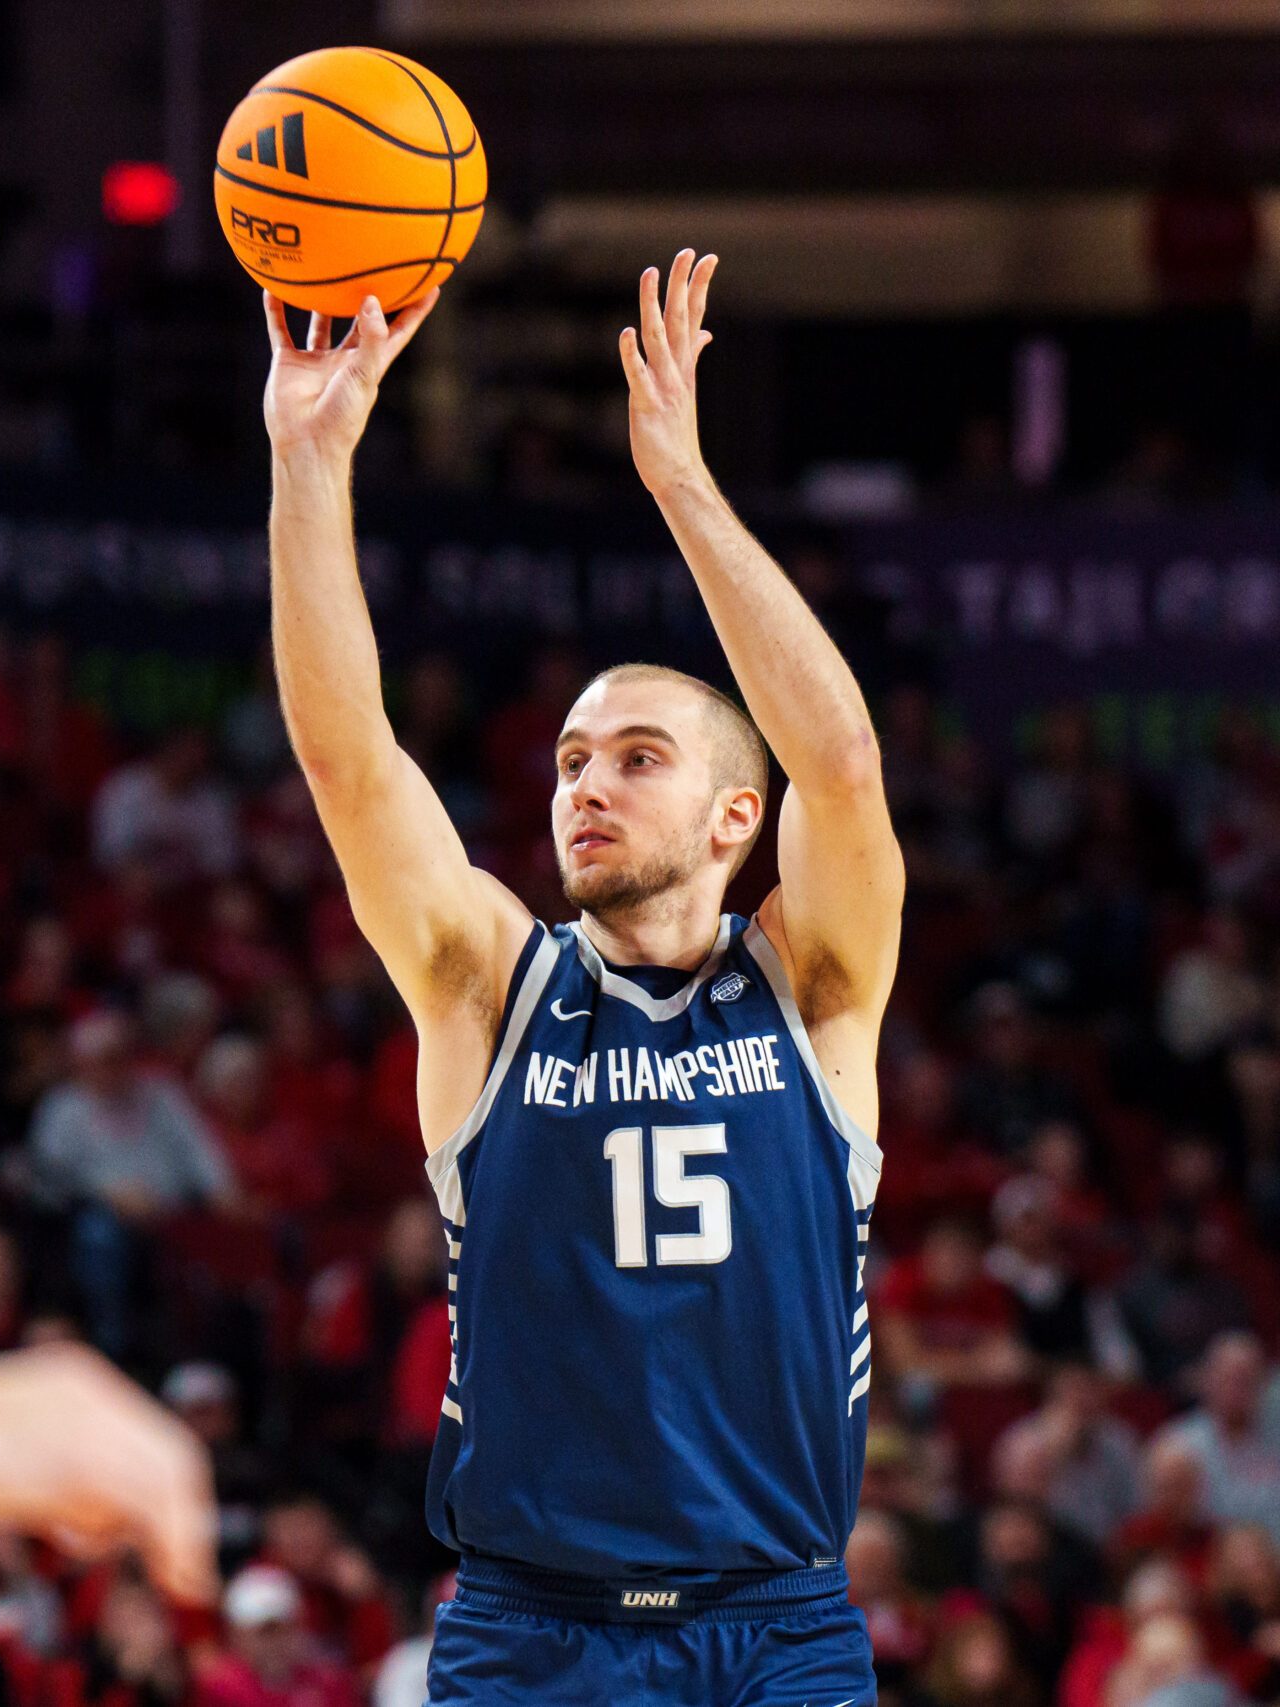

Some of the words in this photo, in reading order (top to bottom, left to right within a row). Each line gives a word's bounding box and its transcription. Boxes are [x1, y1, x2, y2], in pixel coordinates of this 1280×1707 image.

[231, 206, 301, 247] PRO
[524, 1052, 598, 1107] NEW
[608, 1035, 785, 1102] HAMPSHIRE
[604, 1123, 732, 1268] 15
[622, 1592, 678, 1606] UNH
